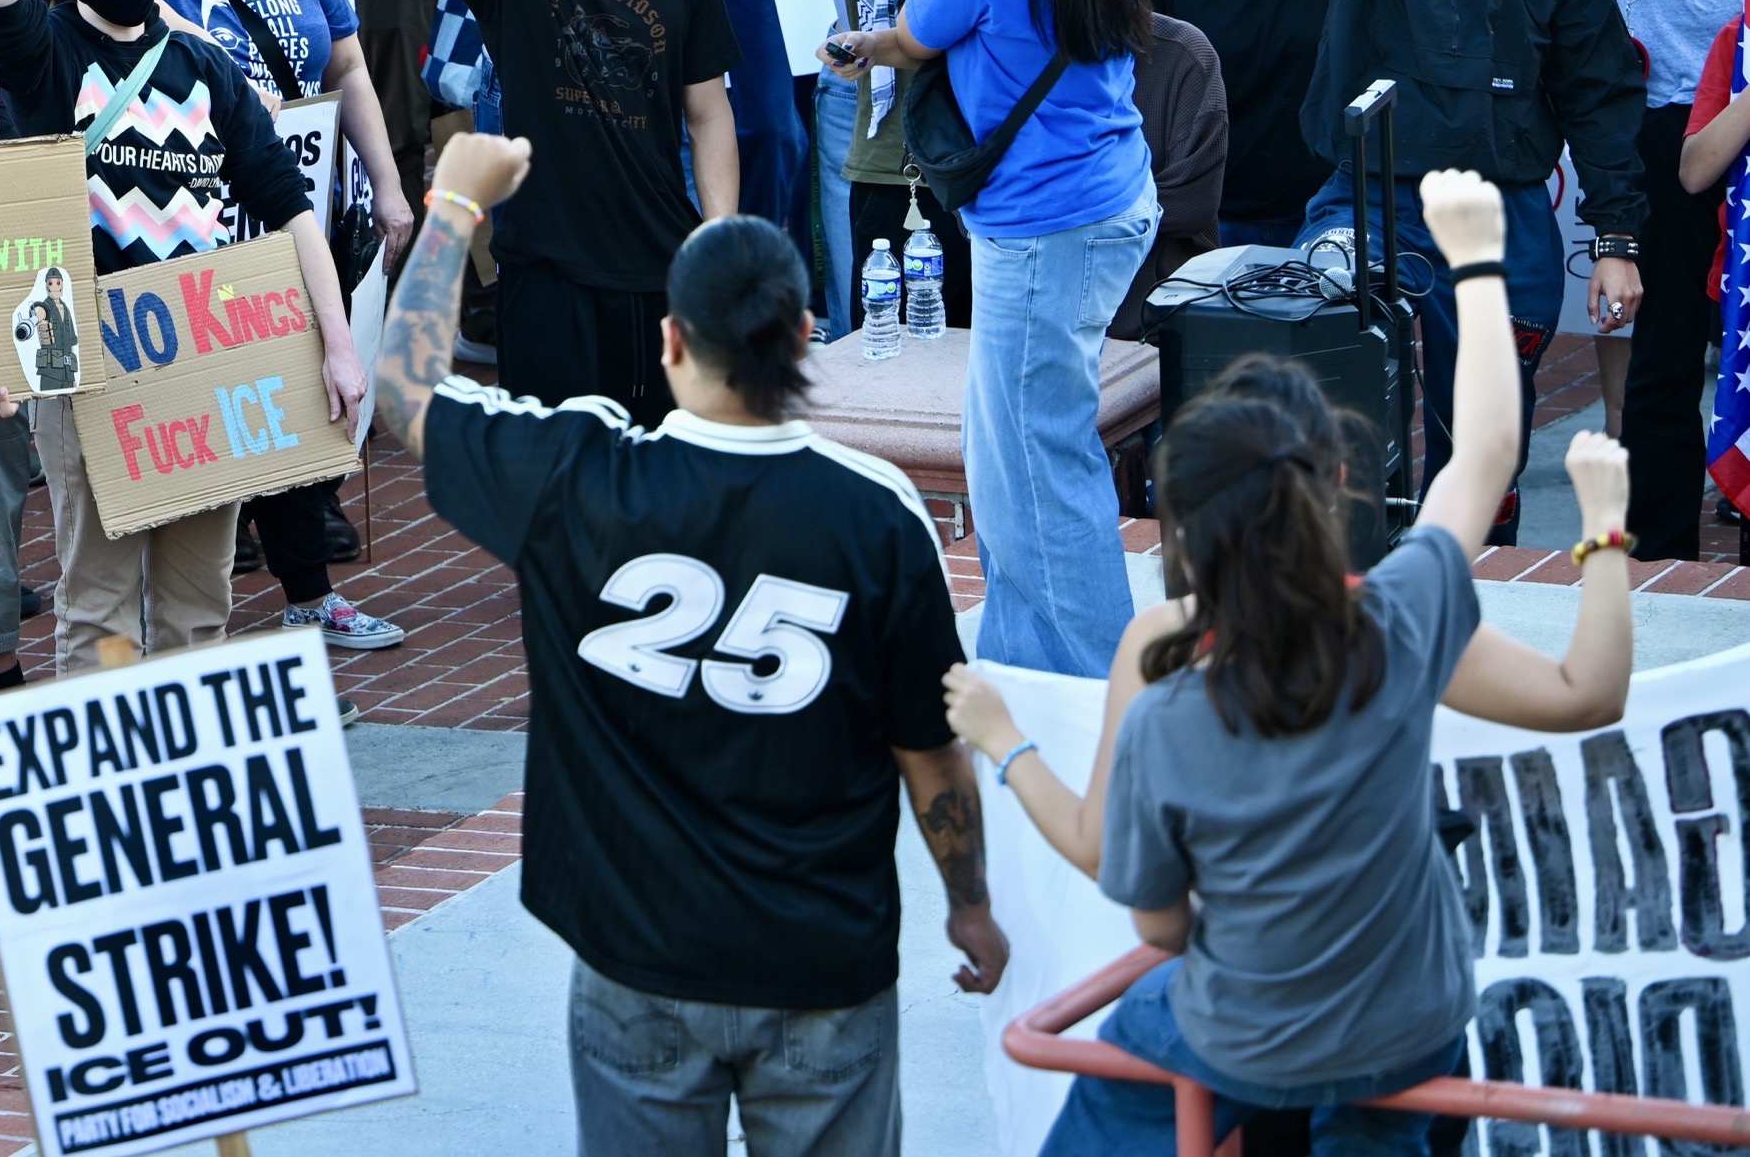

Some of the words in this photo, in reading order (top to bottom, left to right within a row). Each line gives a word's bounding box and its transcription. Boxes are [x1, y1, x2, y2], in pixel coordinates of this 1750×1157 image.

[139, 149, 197, 174] HEARTS
[100, 288, 179, 373] NO
[214, 374, 299, 459] ICE
[577, 553, 850, 714] 25
[199, 655, 317, 748] THE
[46, 883, 347, 1050] STRIKE!
[46, 1042, 175, 1103] ICE
[186, 993, 382, 1067] OUT!
[60, 1108, 122, 1149] PARTY
[120, 1102, 158, 1134] FOR
[156, 1079, 257, 1129] SOCIALISM
[256, 1073, 283, 1101] &
[283, 1044, 392, 1096] LIBERATION
